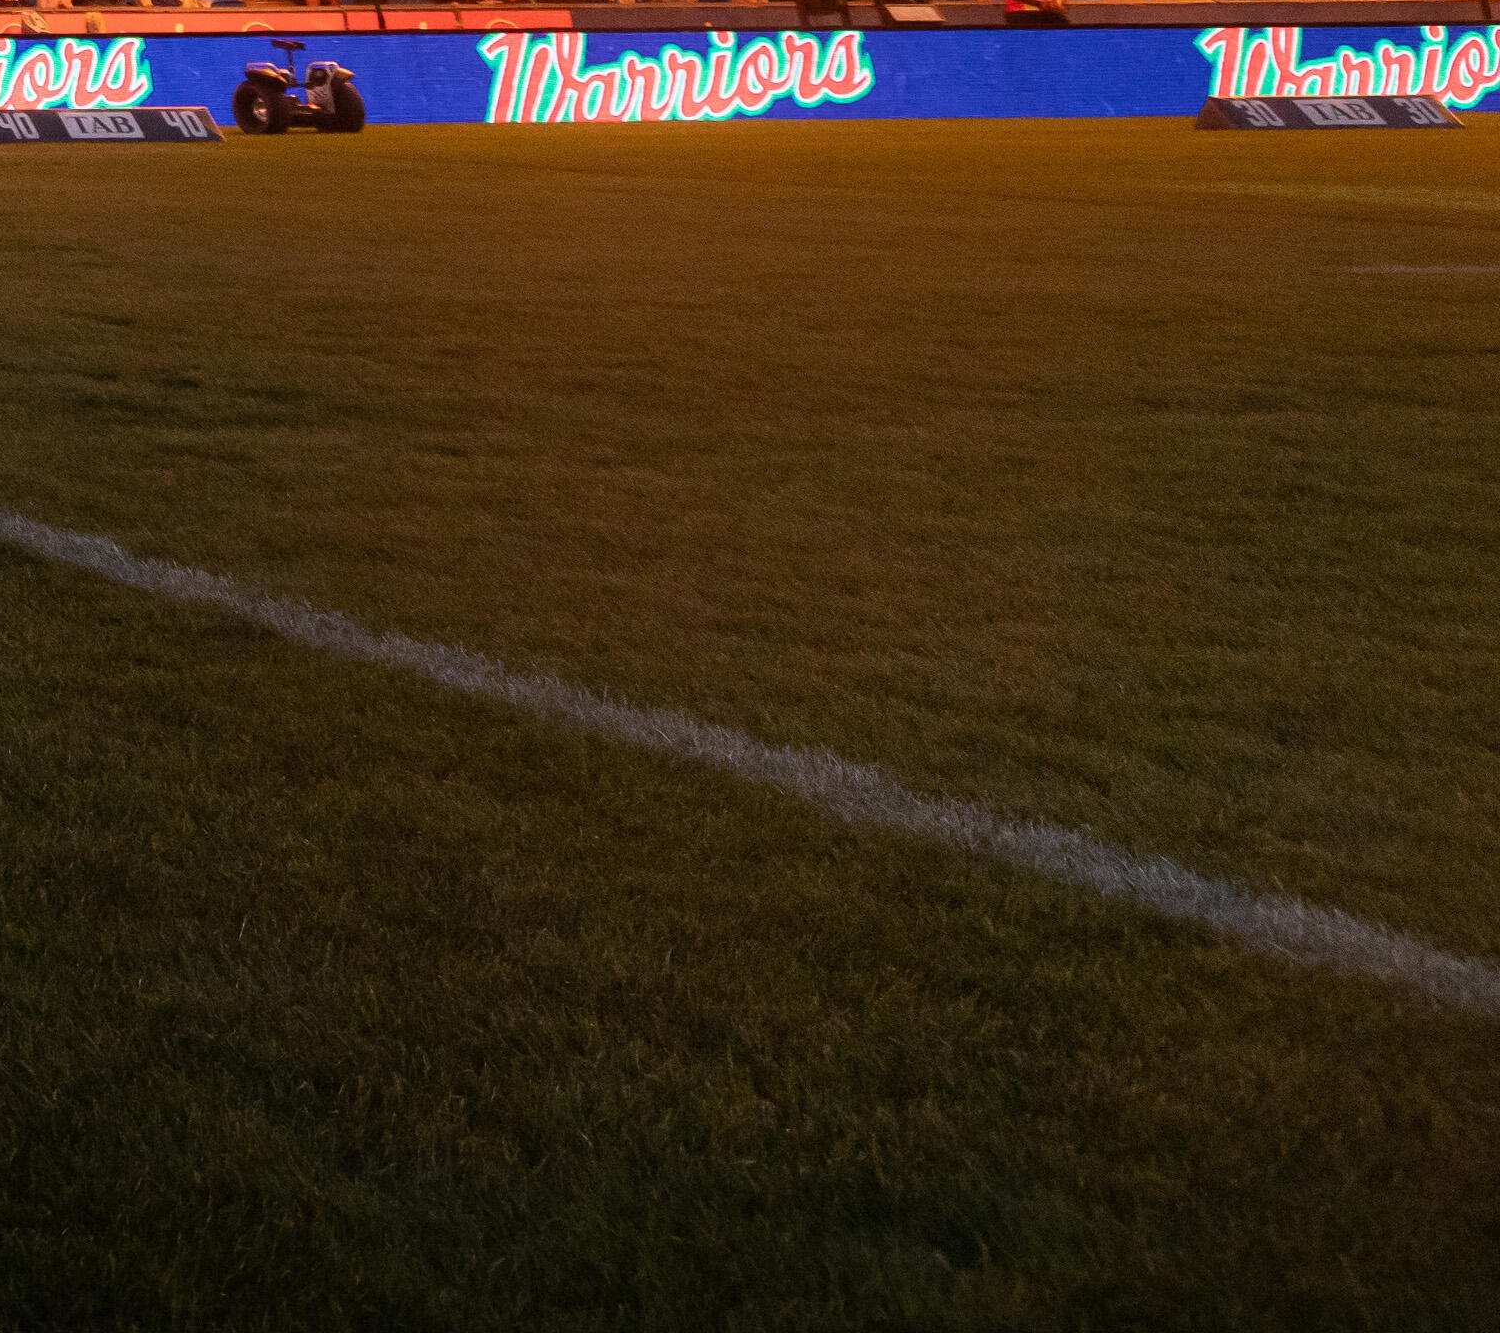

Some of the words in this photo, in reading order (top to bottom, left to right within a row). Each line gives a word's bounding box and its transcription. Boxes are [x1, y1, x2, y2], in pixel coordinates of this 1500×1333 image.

[477, 31, 876, 123] Warriors
[1193, 25, 1500, 109] Warrio
[73, 115, 136, 135] TAB
[161, 111, 208, 137] 40
[1236, 101, 1285, 128] 30
[1310, 103, 1375, 124] TAB
[1394, 99, 1446, 125] 30
